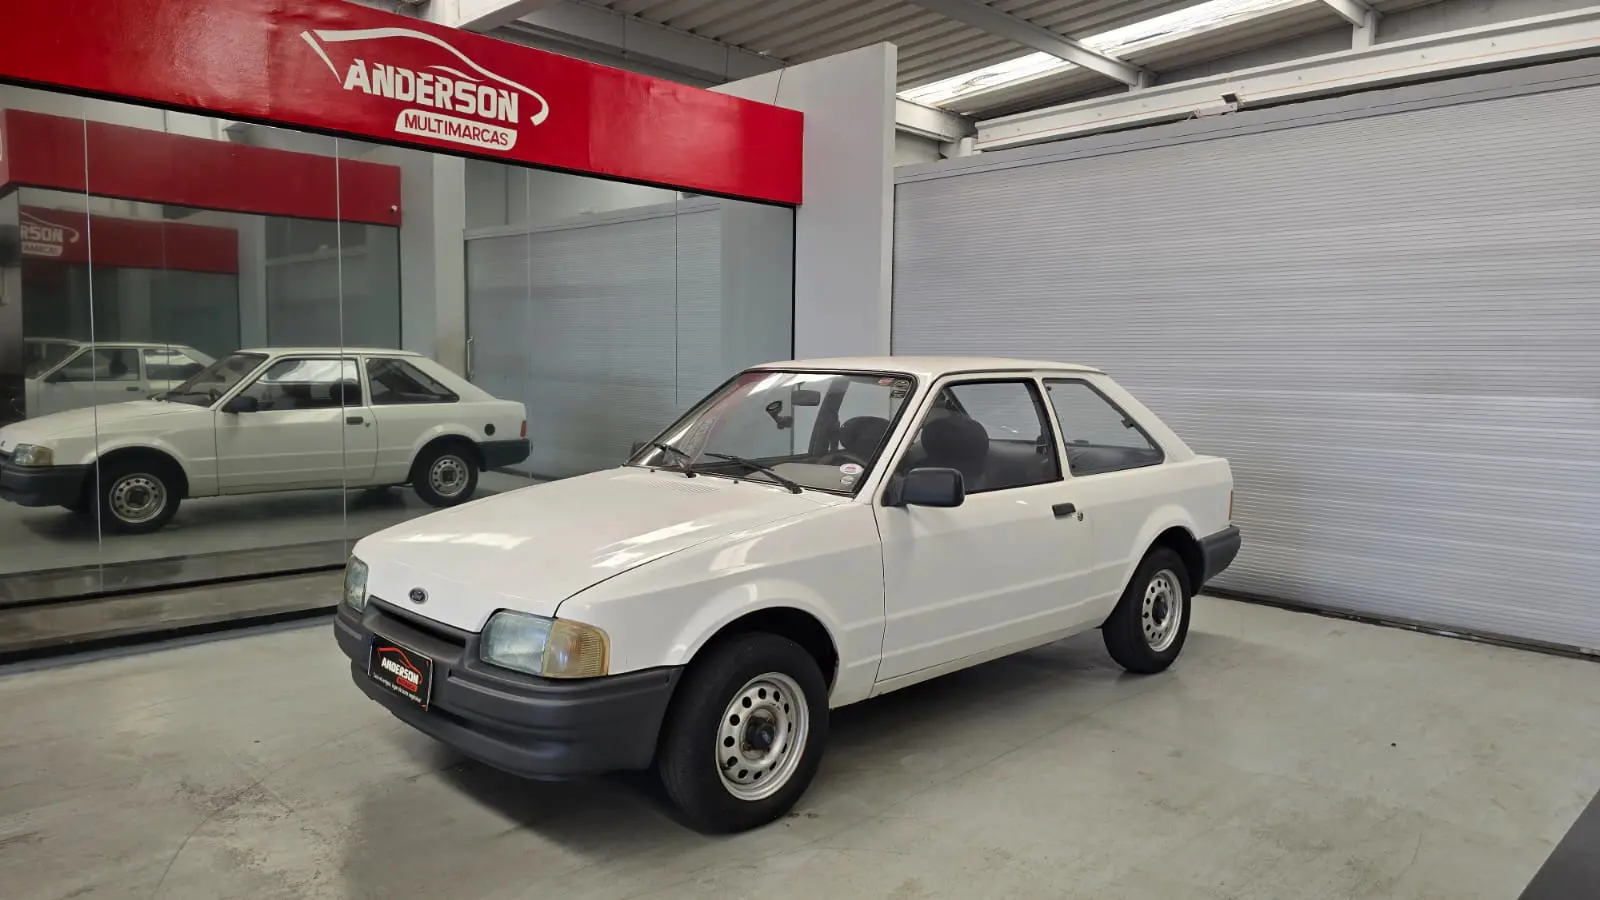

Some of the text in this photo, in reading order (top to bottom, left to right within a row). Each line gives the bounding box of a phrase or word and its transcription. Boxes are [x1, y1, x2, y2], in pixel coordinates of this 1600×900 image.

[343, 58, 519, 123] ANDERSON
[404, 112, 509, 146] MULTIMARCAS
[380, 657, 420, 685] ANDERSON
